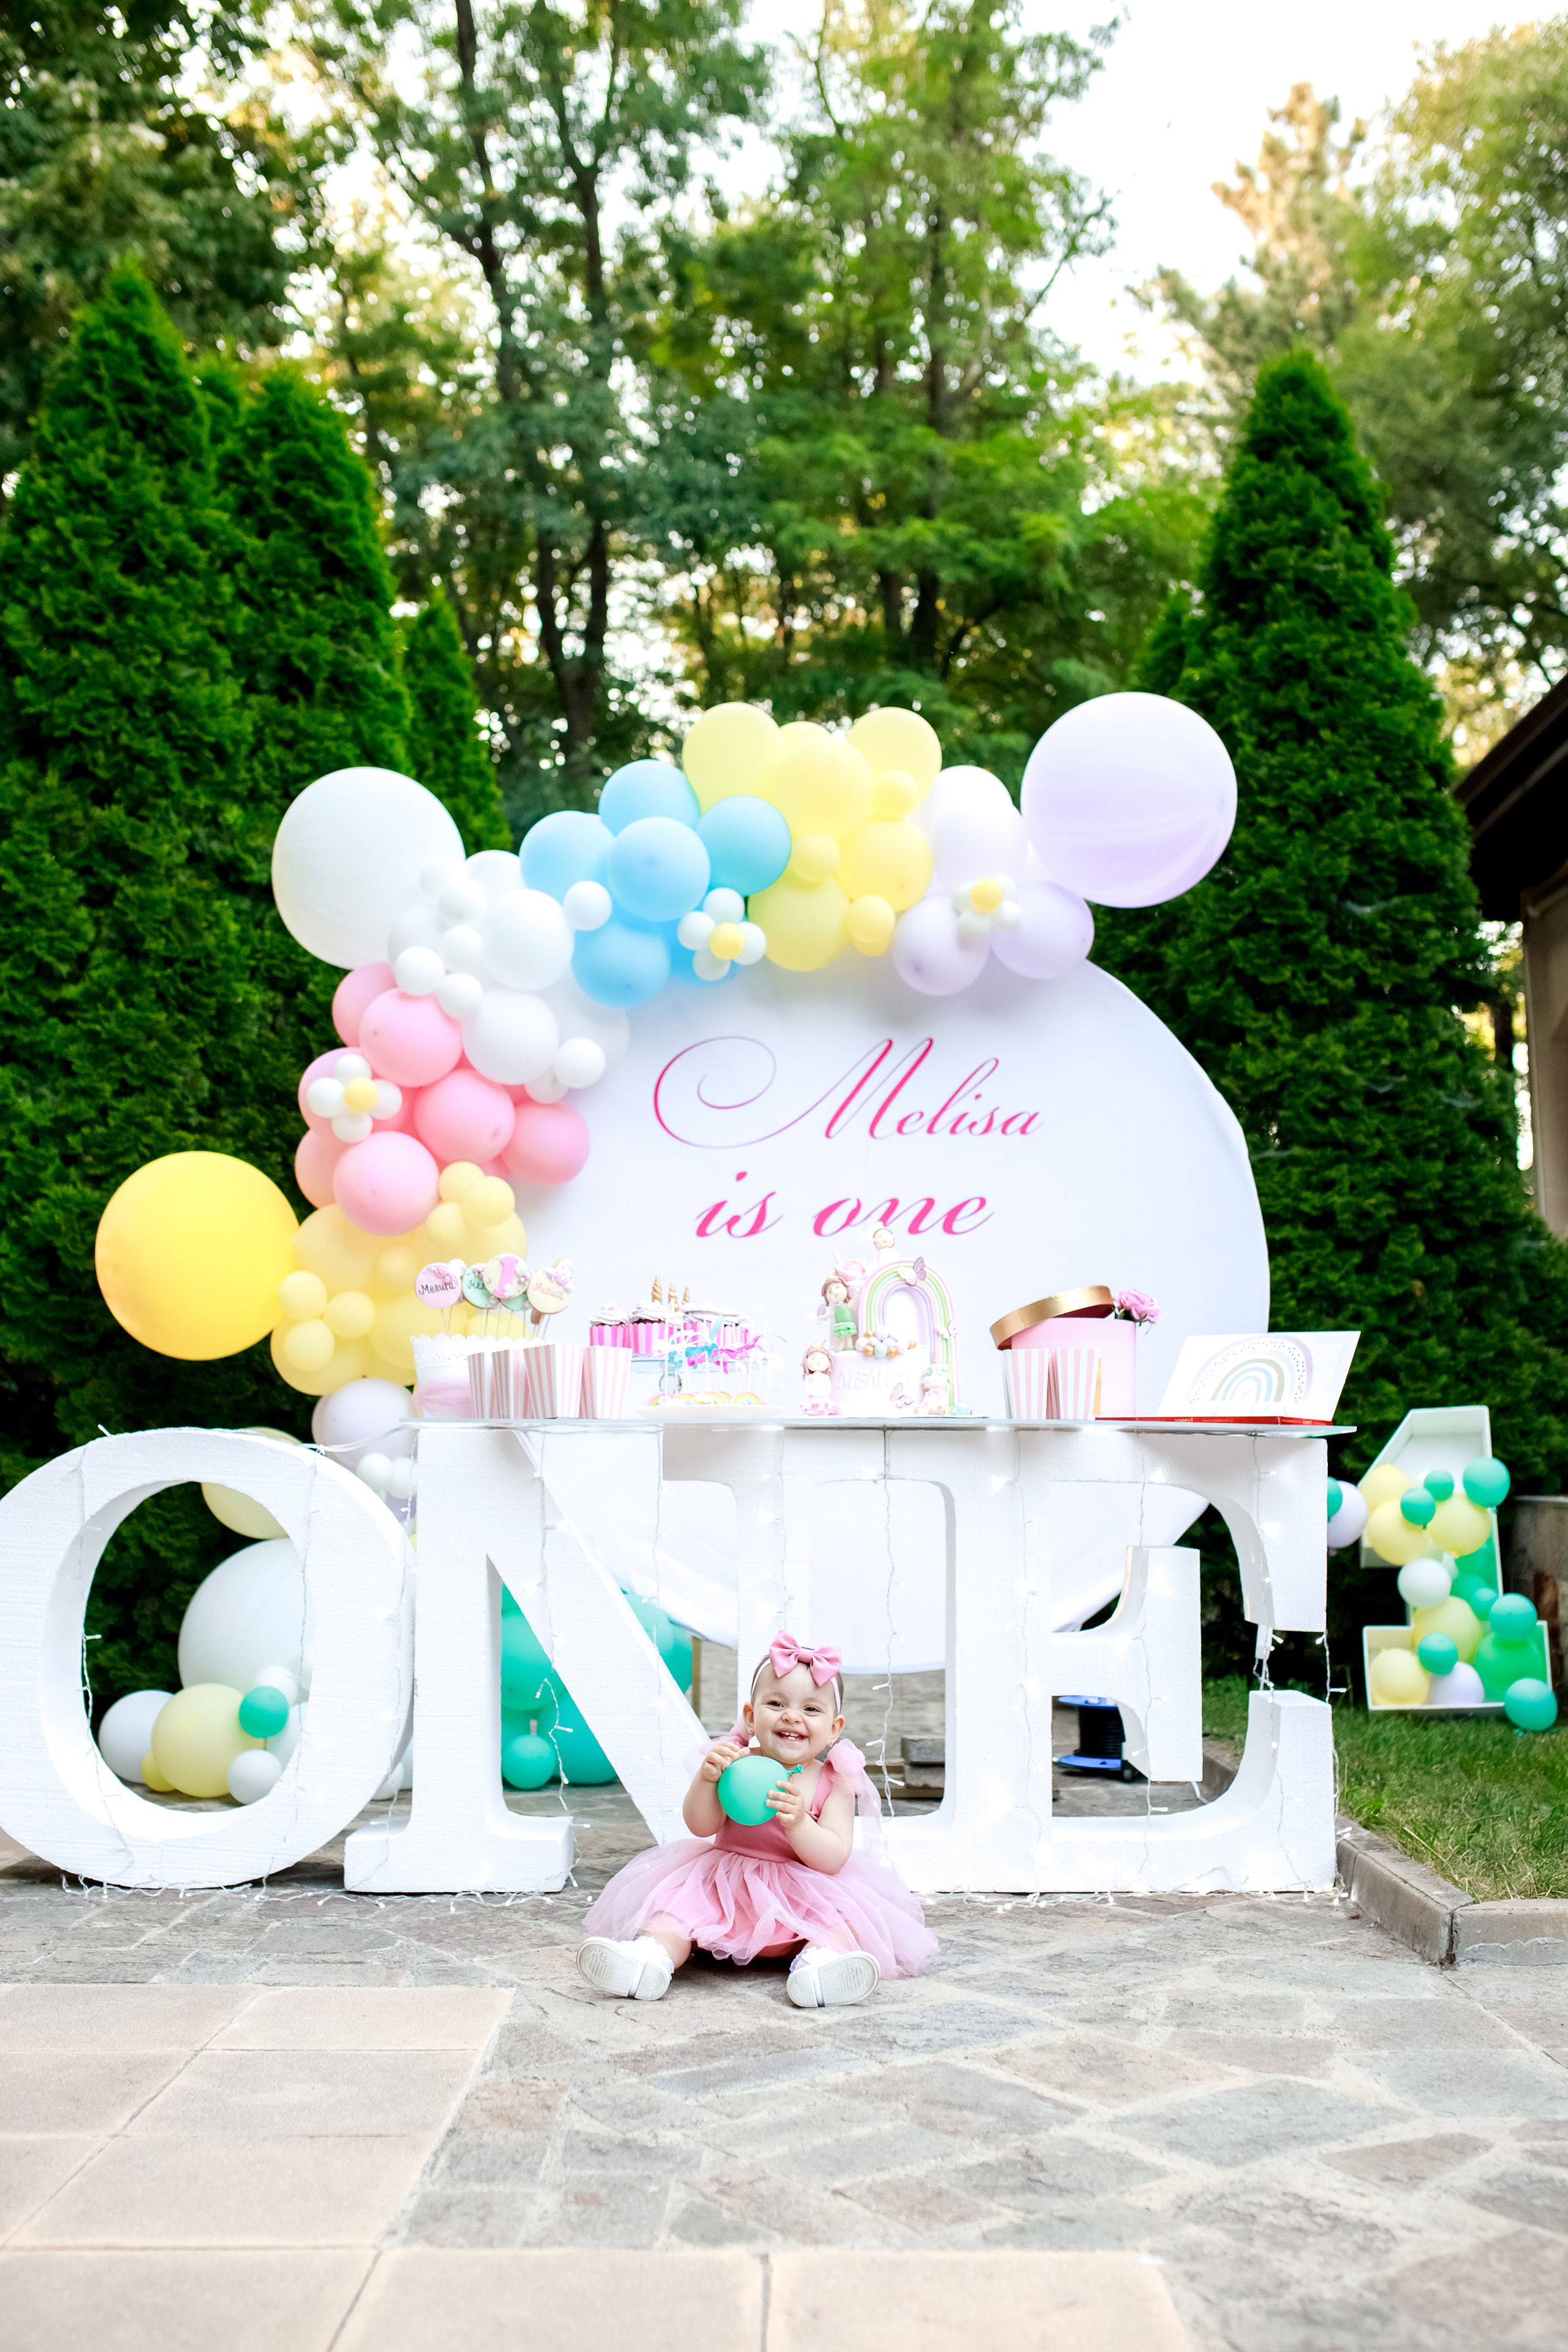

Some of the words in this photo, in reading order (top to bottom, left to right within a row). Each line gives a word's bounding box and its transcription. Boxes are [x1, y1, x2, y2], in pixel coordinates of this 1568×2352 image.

[654, 1036, 1044, 1148] Melisa
[695, 1170, 785, 1238] is
[812, 1196, 995, 1237] one
[467, 1280, 487, 1291] Мел
[0, 1427, 1338, 1893] ONE
